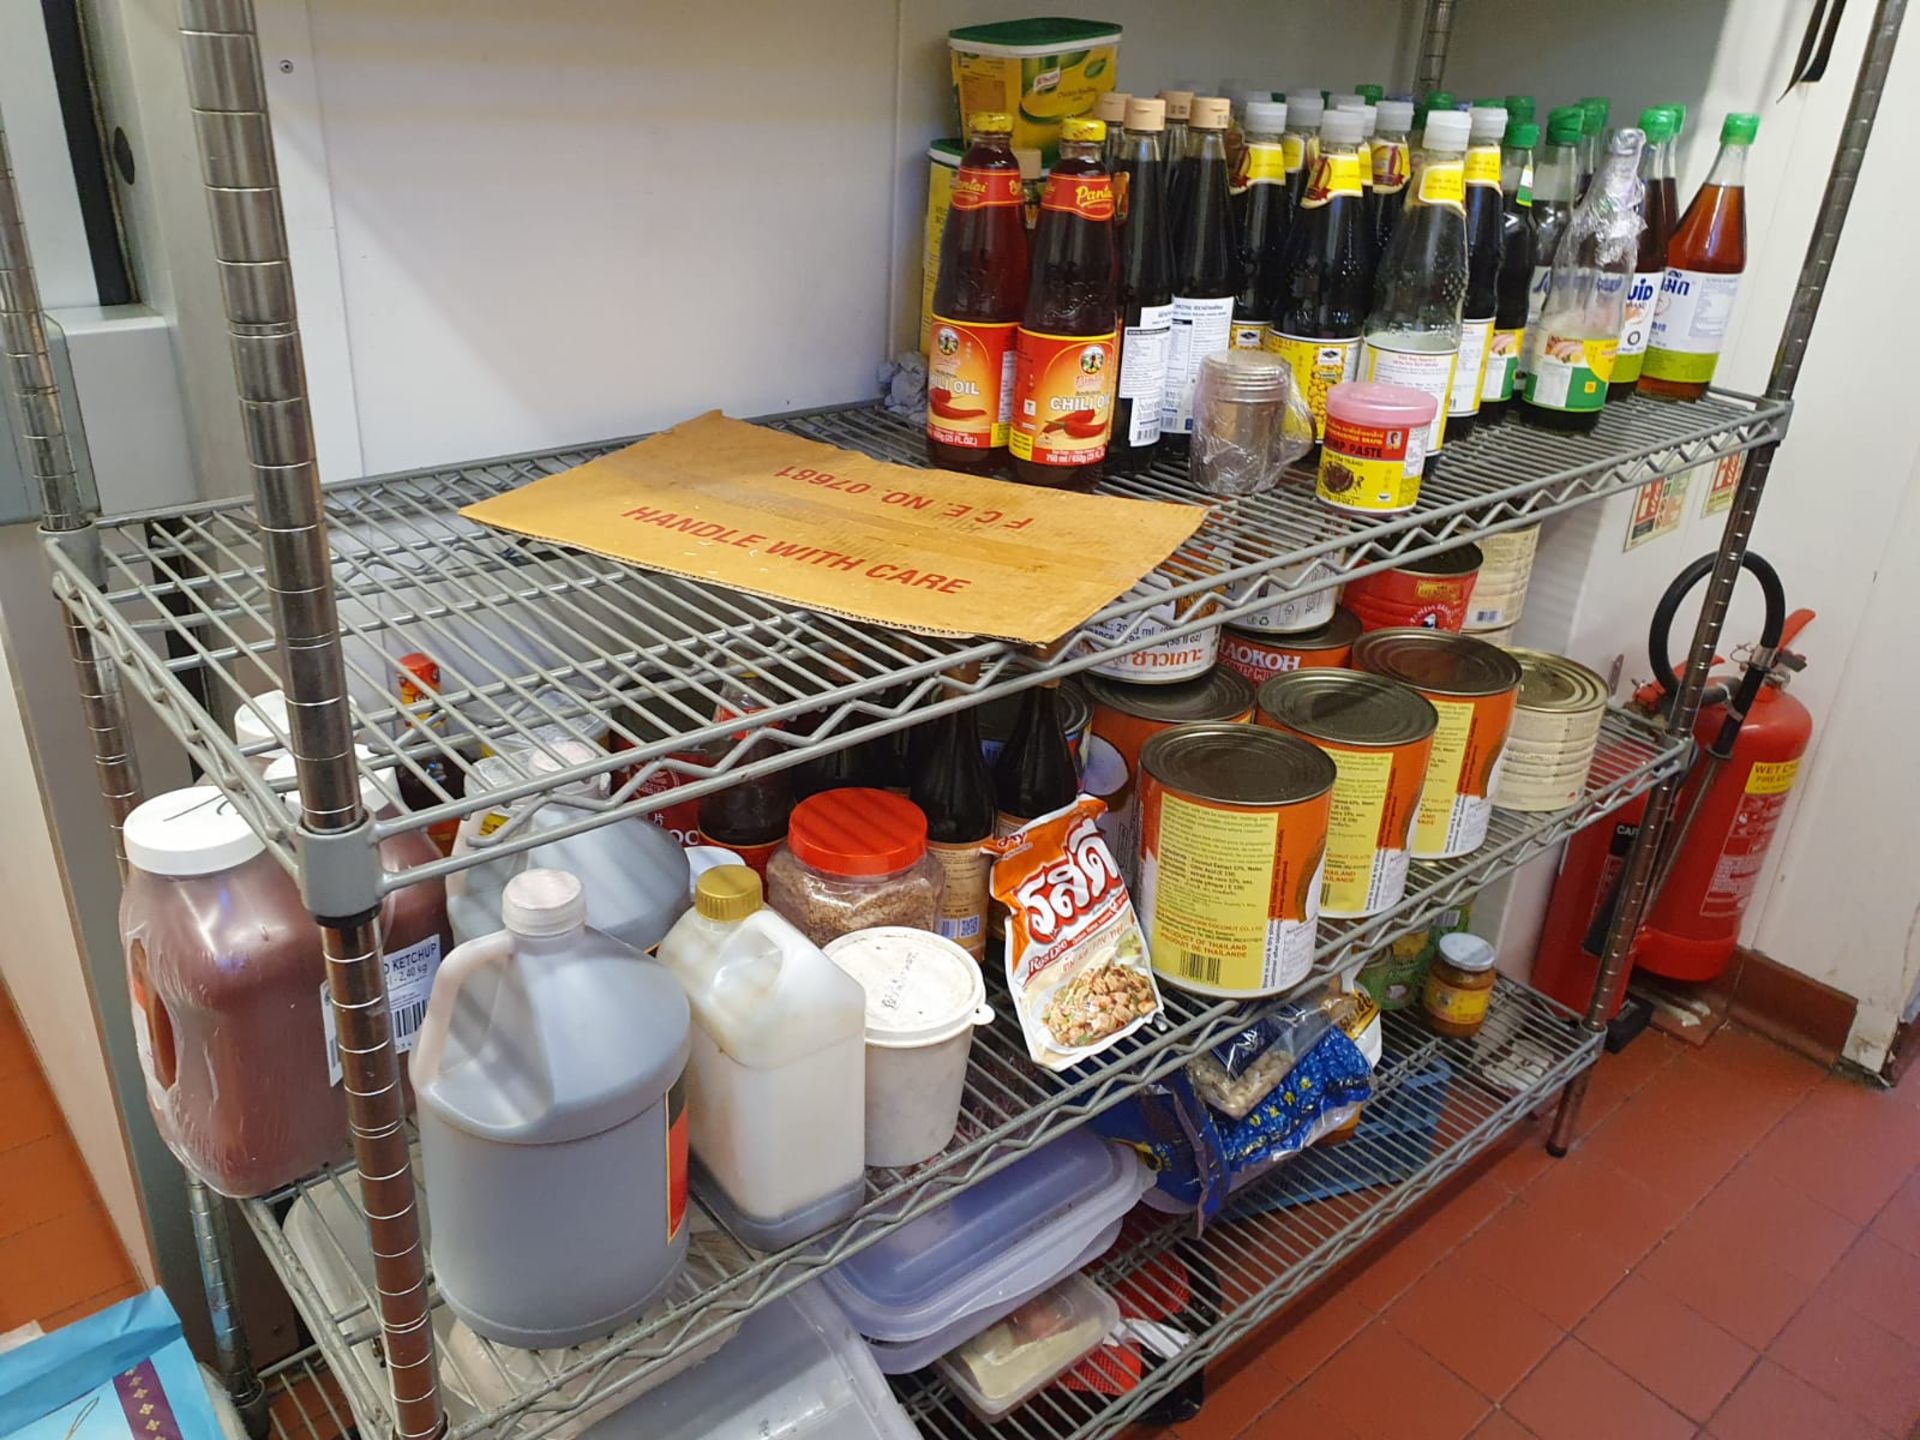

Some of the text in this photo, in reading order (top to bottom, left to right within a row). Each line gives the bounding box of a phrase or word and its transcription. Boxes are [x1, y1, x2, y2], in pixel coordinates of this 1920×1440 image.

[954, 381, 979, 395] OIL
[1050, 396, 1093, 412] CHILI
[1349, 443, 1383, 458] PASTE
[774, 464, 872, 495] 07681
[881, 487, 934, 511] NO.
[620, 506, 972, 595] HANDLE WITH CARE
[1755, 764, 1781, 775] WET
[1016, 817, 1119, 941] รสดี
[1160, 924, 1195, 943] PRODUCT
[1208, 940, 1248, 951] THAILAND
[392, 942, 438, 972] KETCHUP
